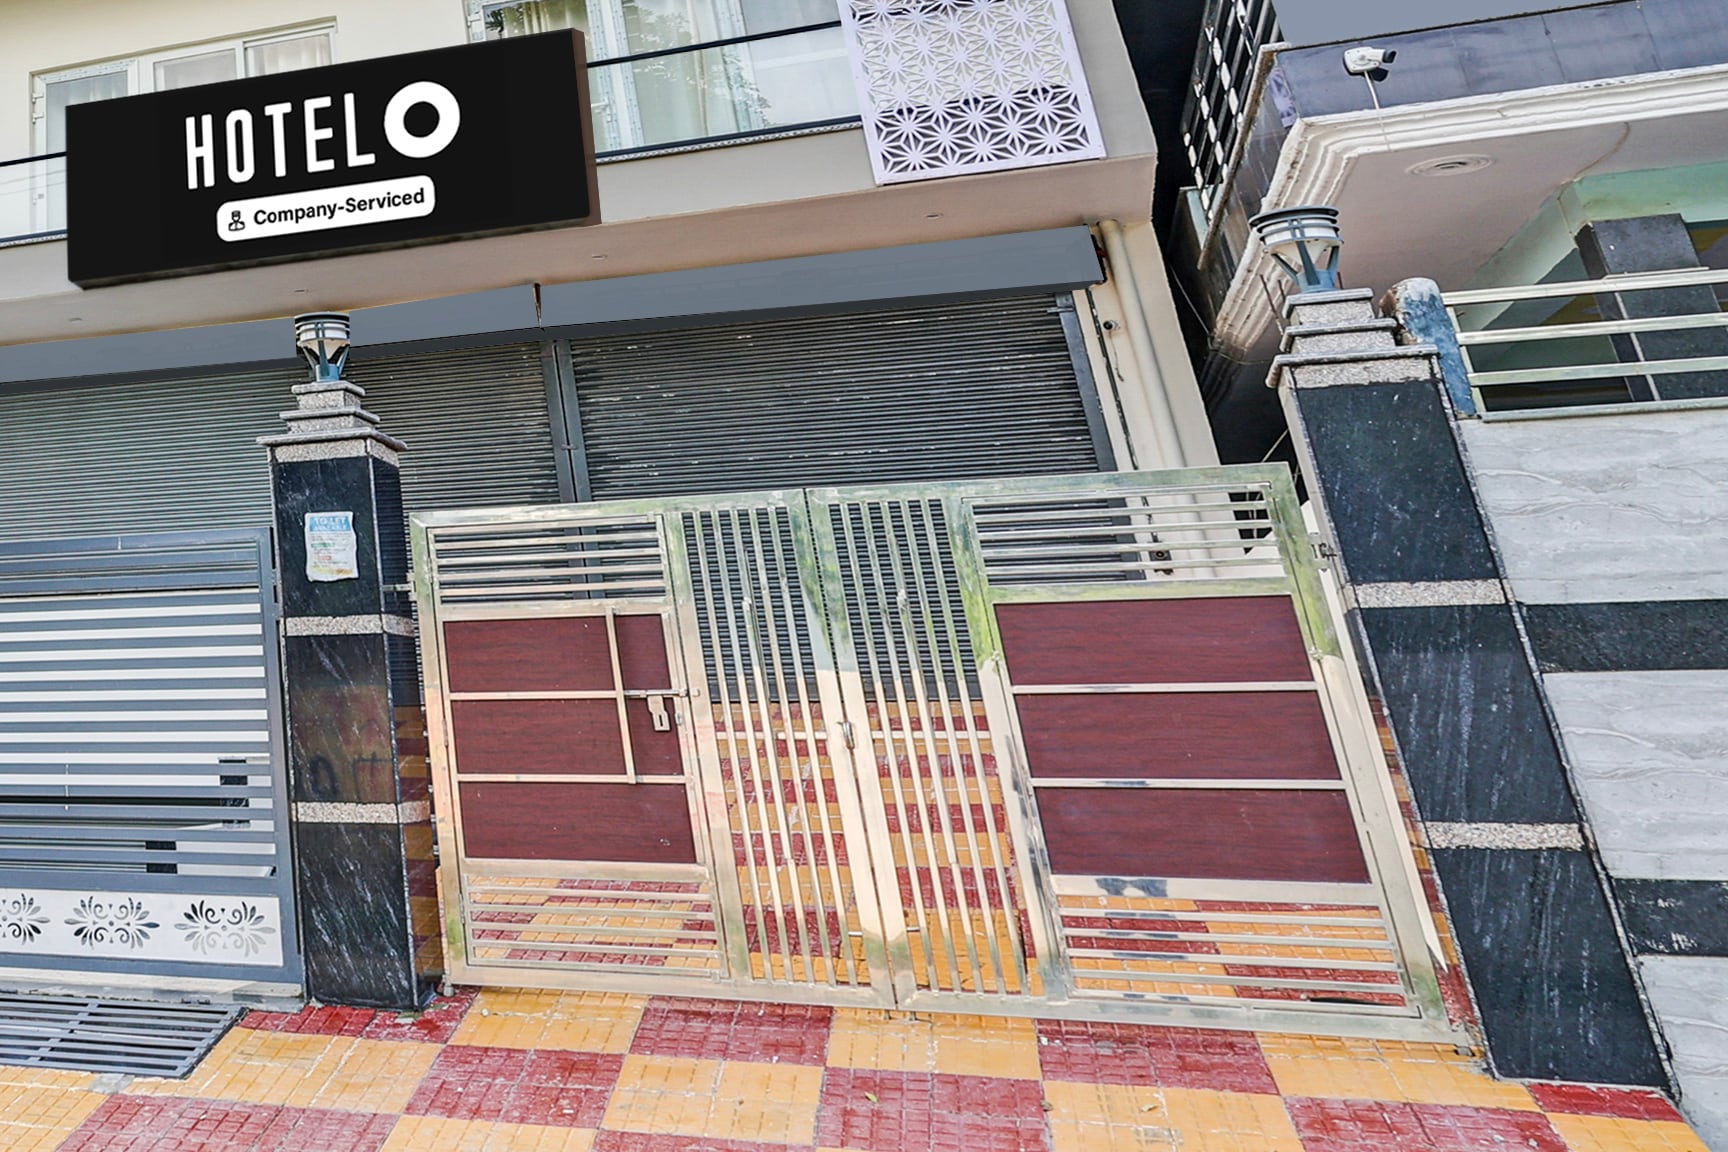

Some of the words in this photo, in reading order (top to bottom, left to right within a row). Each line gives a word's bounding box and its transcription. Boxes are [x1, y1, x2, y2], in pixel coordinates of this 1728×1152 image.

[186, 93, 375, 189] HOTEL
[384, 81, 461, 158] O
[254, 188, 425, 225] Company-Serviced
